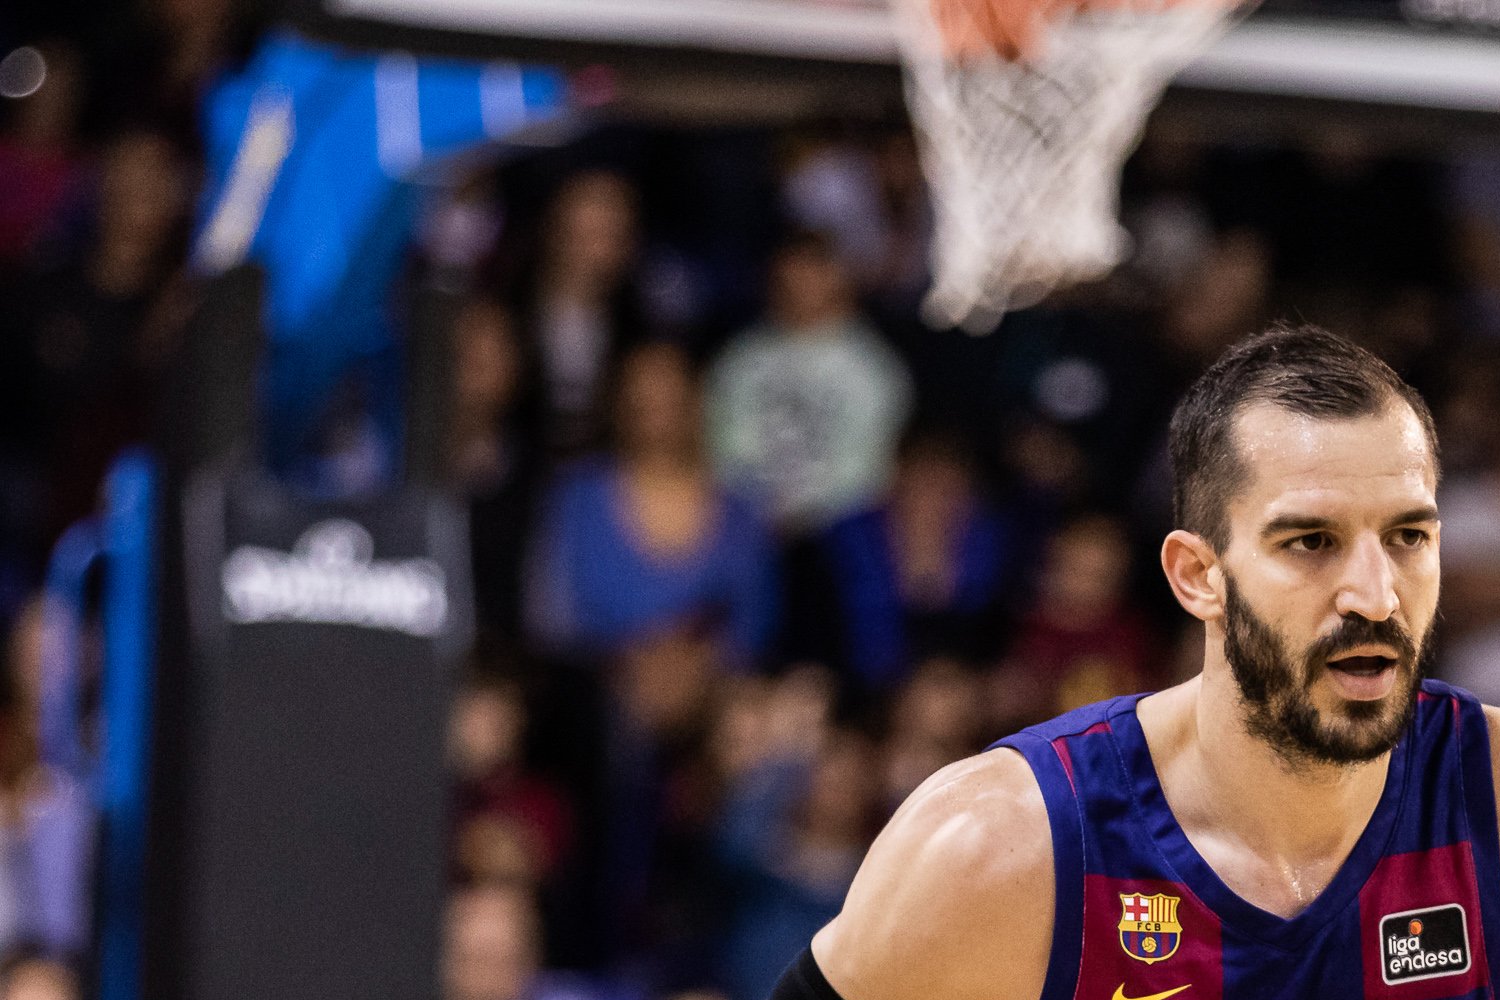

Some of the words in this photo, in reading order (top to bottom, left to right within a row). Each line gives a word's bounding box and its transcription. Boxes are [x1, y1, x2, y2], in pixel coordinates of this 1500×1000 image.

[1136, 922, 1162, 932] FCB
[1388, 935, 1420, 956] liga
[1389, 949, 1463, 974] endesa
